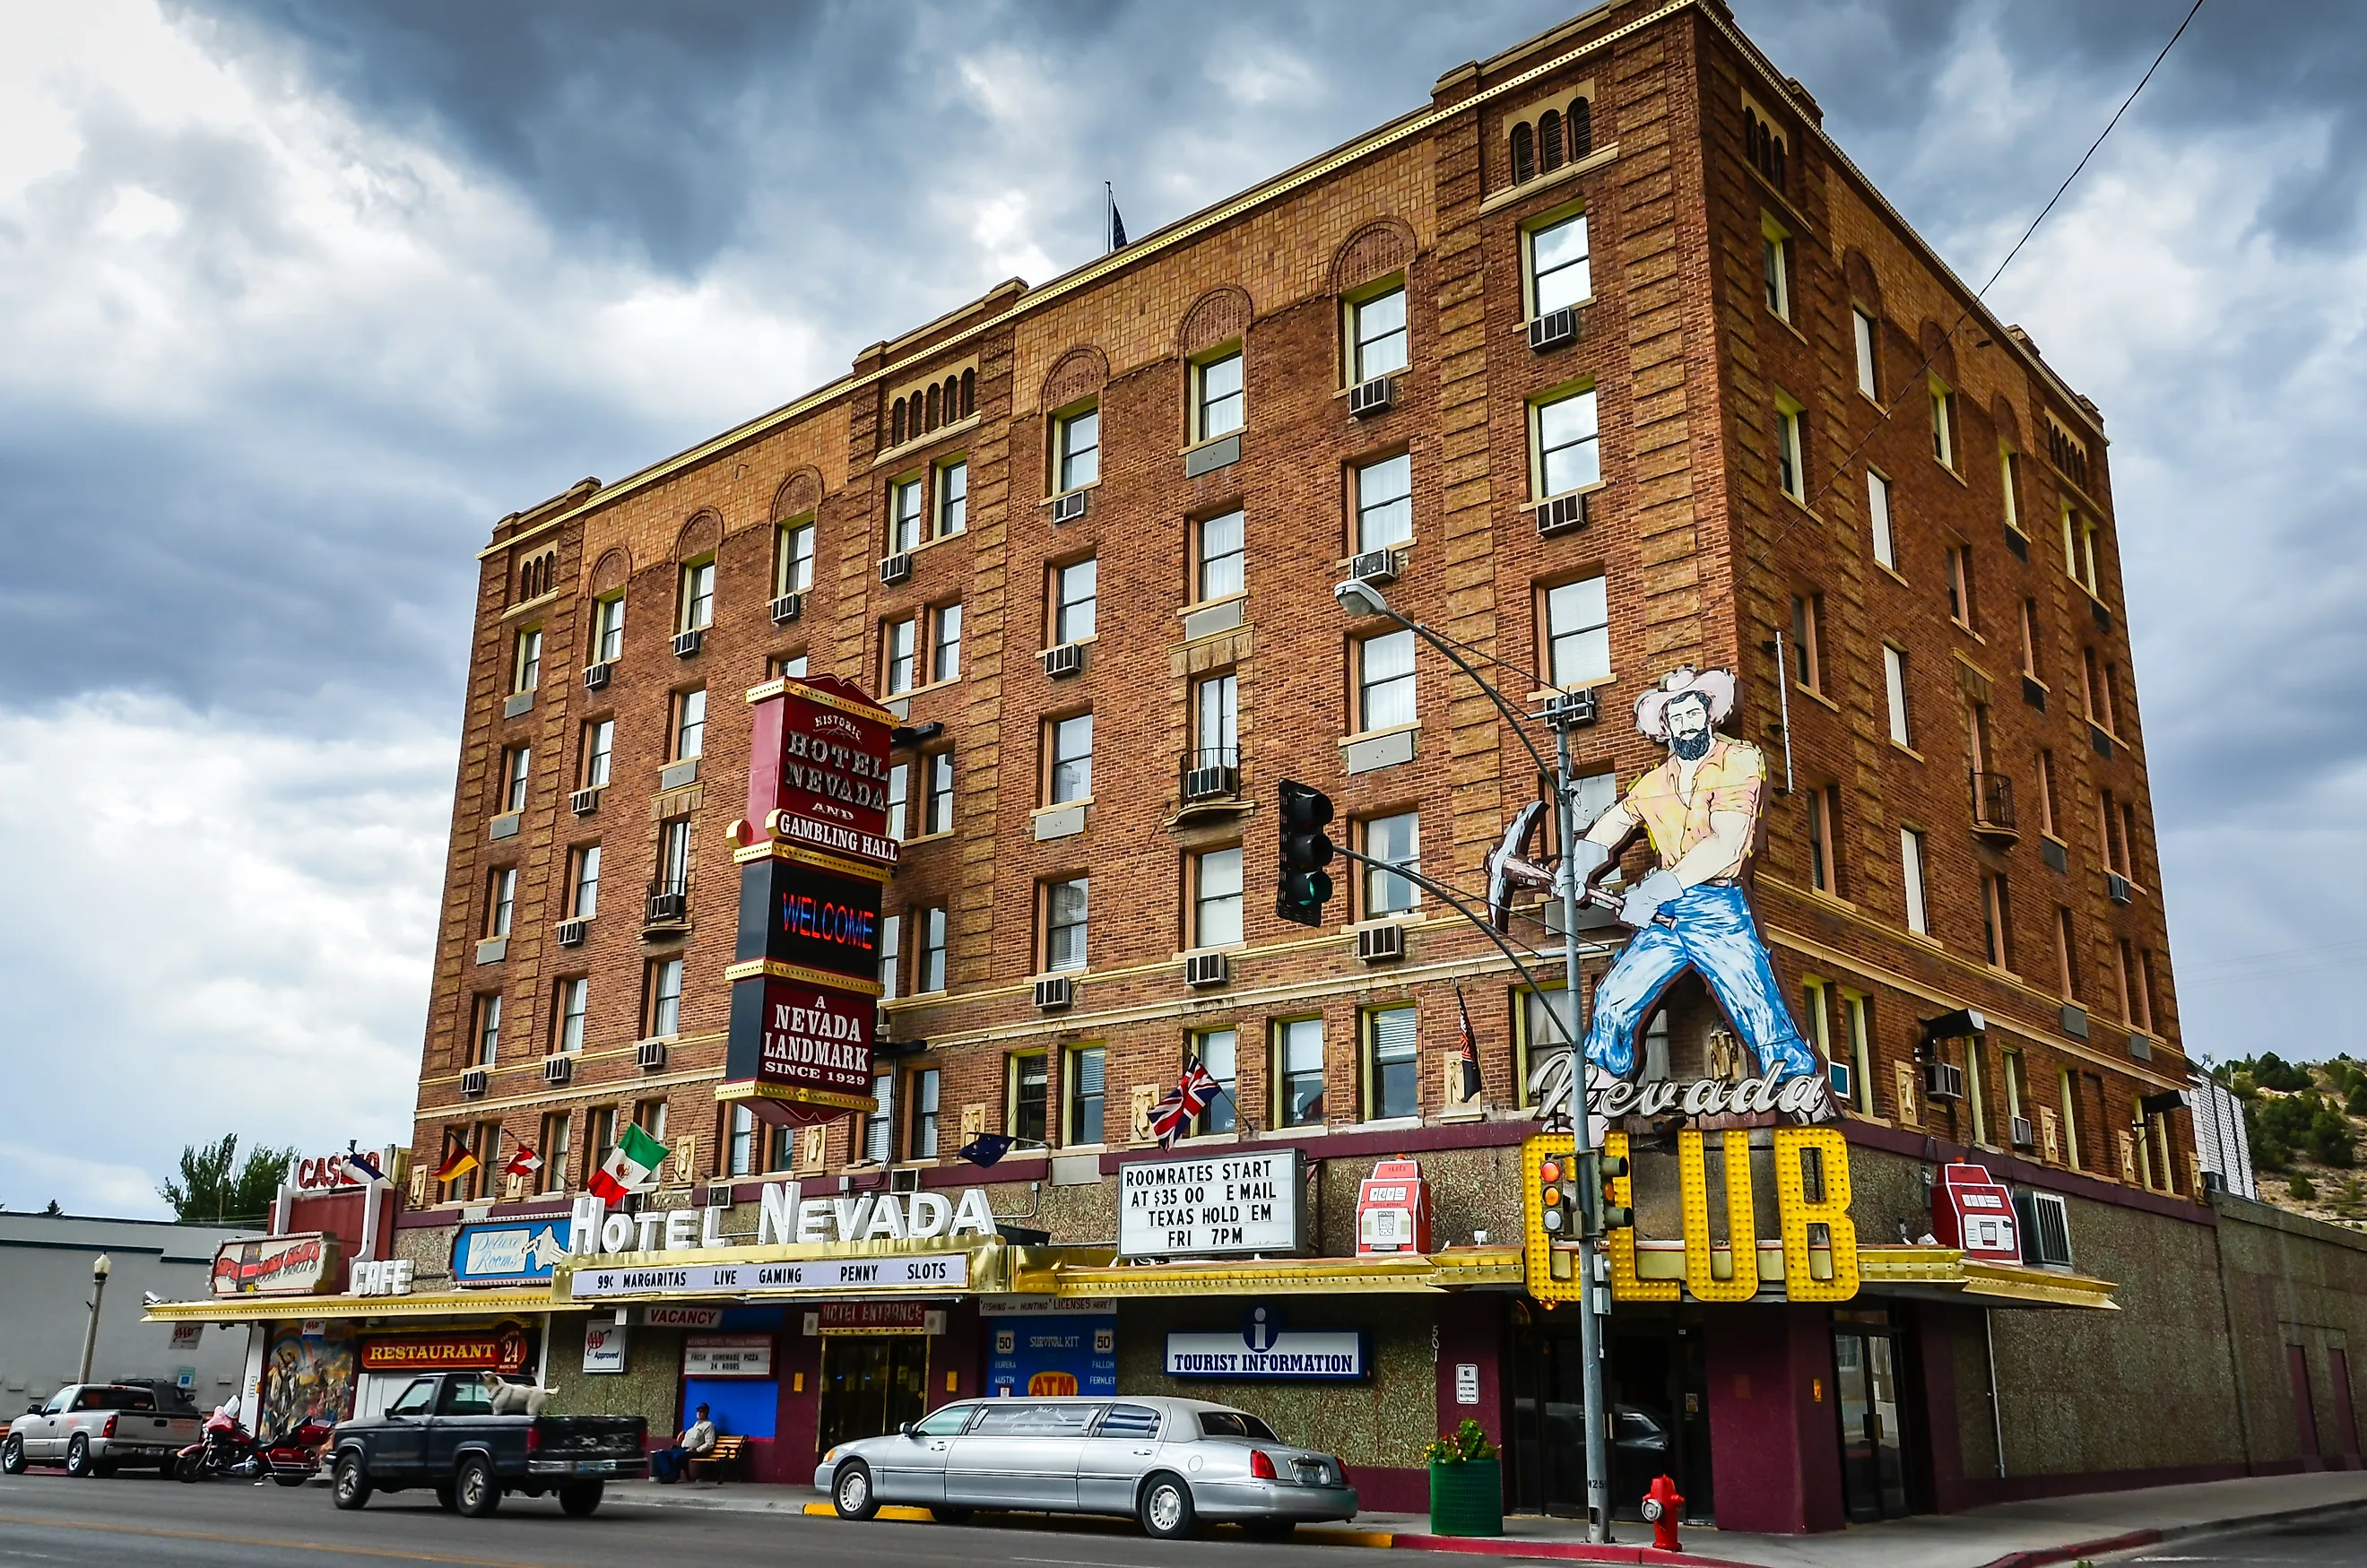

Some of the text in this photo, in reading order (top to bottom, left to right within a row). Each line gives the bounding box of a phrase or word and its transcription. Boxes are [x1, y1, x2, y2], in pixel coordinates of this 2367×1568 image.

[814, 715, 862, 741] HISTORIC
[788, 730, 888, 781] HOTEL
[785, 761, 886, 811] NEVADA
[811, 802, 854, 820] AND
[780, 814, 897, 861] GAMBLING HALL
[783, 892, 874, 949] WELCOME
[815, 996, 826, 1009] A
[774, 1004, 862, 1043] NEVADA
[764, 1032, 869, 1071] LANDMARK
[765, 1061, 865, 1086] SINCE 1929
[1527, 1052, 1827, 1120] Nevada
[298, 1151, 380, 1190] CASO
[1126, 1160, 1271, 1187] ROOMRATES START
[1131, 1182, 1277, 1208] AT $35 00 E MAIL
[569, 1182, 998, 1255] HOTEL NEVADA
[1148, 1203, 1271, 1227] TEXAS HOLD 'EM
[1523, 1126, 1860, 1302] CLUB
[473, 1233, 520, 1252] Deluxe
[1168, 1227, 1243, 1247] FRI 7PM
[473, 1252, 517, 1272] Rooms
[351, 1259, 415, 1295] CAFE
[597, 1262, 947, 1289] 99¢ MARGARITAS LIVE GAMING PENNY SLOTS
[823, 1304, 922, 1321] HOTEL ENTRANCE
[1053, 1298, 1091, 1310] LICENSES
[649, 1310, 716, 1324] VACANCY
[587, 1330, 604, 1349] AAA
[999, 1337, 1011, 1349] 50
[1029, 1336, 1079, 1347] SURVIVAL KIT
[1097, 1336, 1110, 1348] 50
[369, 1344, 496, 1360] RESTAURANT
[504, 1340, 518, 1363] 24
[594, 1351, 619, 1361] Approved
[1174, 1354, 1353, 1373] TOURIST INFORMATION
[994, 1376, 1015, 1384] AUSTIN
[1032, 1376, 1074, 1396] ATM
[1089, 1376, 1116, 1385] FERNLEY
